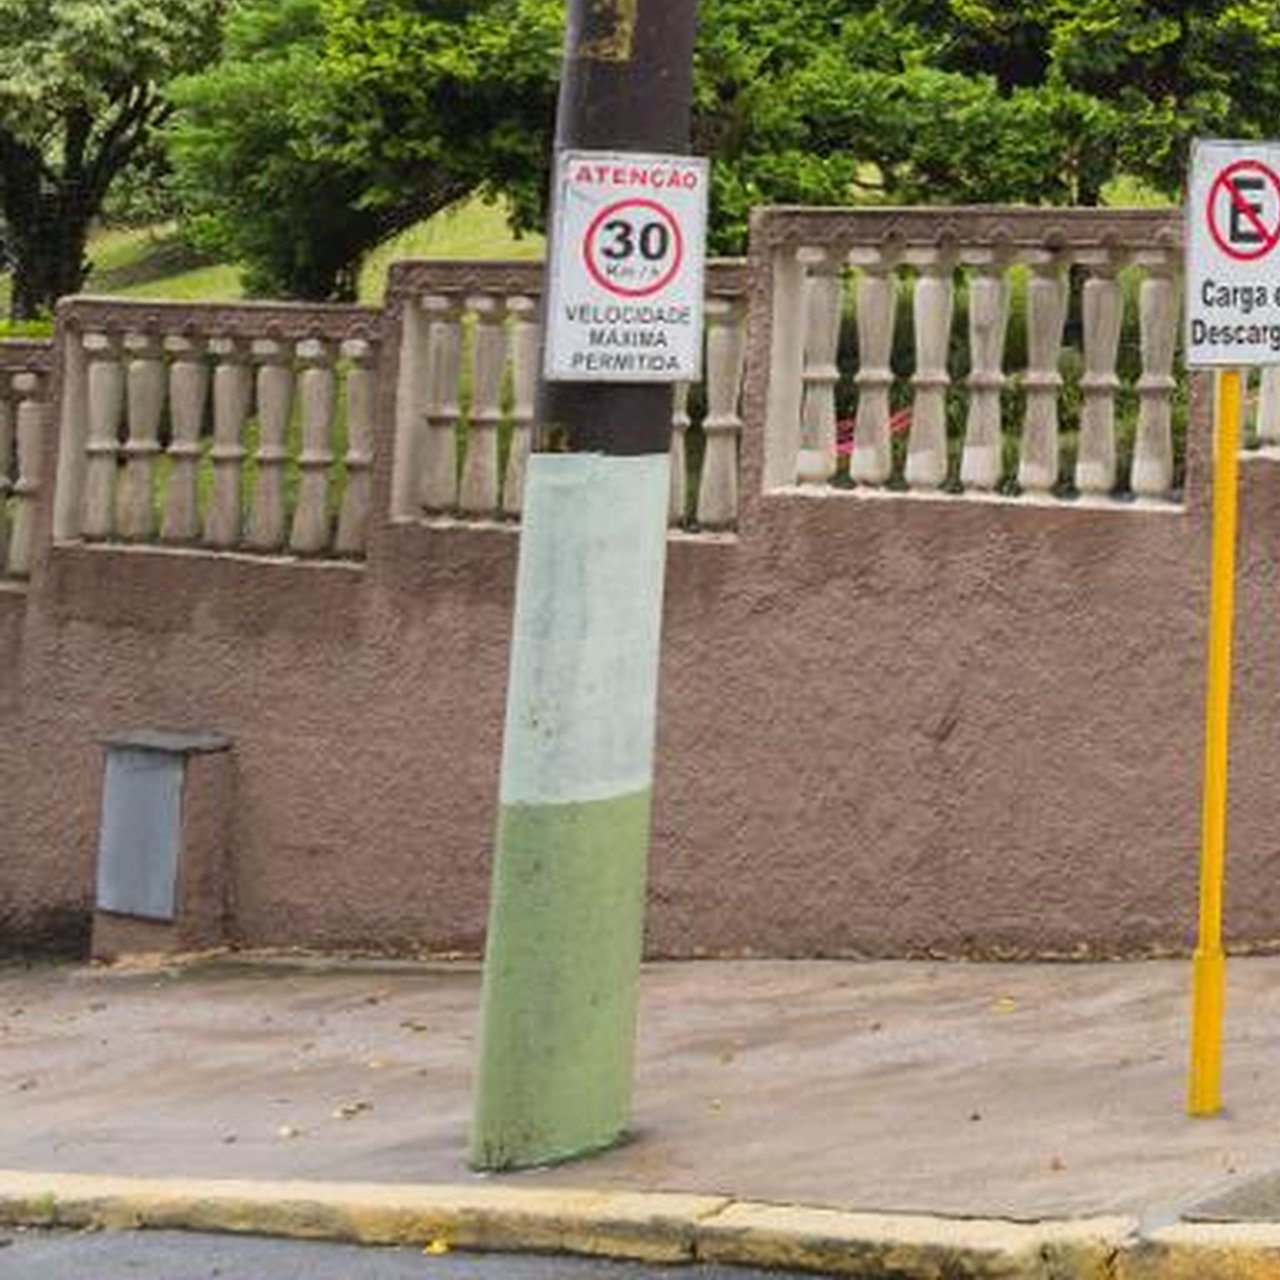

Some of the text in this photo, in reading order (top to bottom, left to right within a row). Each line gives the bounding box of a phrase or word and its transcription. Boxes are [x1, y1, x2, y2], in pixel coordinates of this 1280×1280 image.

[1230, 177, 1266, 242] E
[601, 220, 669, 261] 30
[1202, 280, 1269, 313] Carga
[565, 305, 692, 324] VELOCIDADE
[572, 352, 681, 371] PERMITIDA
